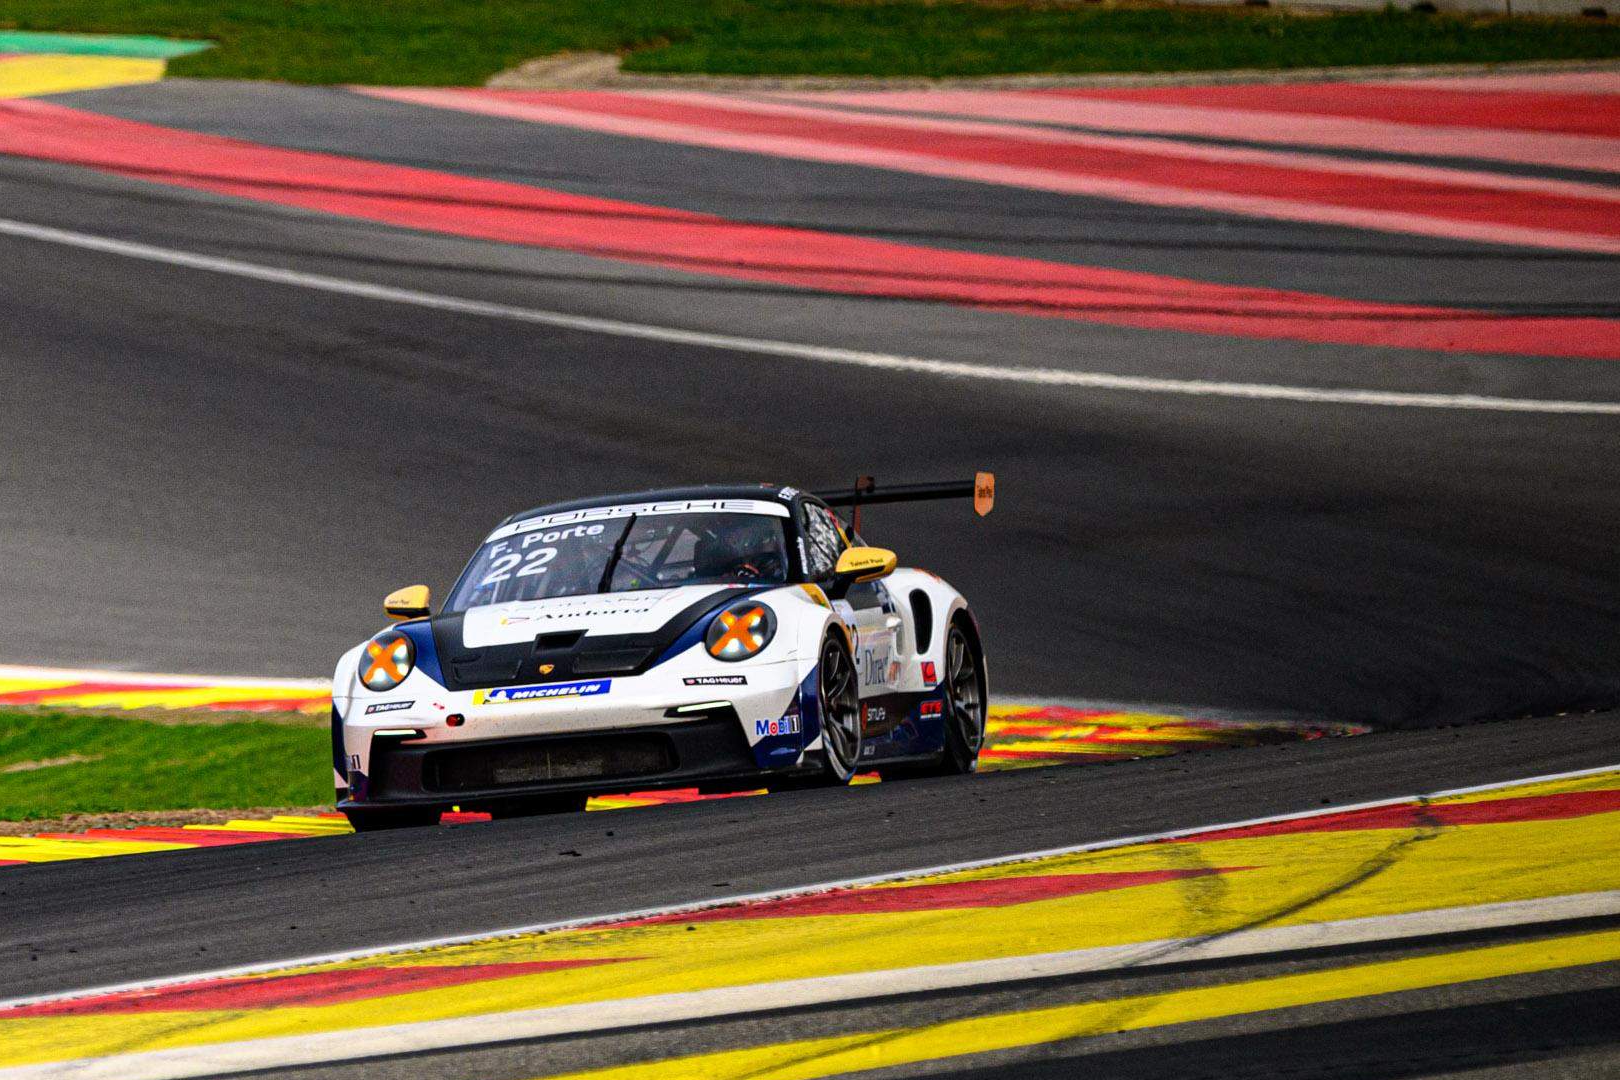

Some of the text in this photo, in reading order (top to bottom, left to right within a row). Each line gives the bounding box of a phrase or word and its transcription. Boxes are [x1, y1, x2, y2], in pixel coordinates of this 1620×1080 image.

[489, 524, 605, 559] F. Porte
[481, 547, 558, 585] 22
[511, 684, 601, 699] MICHELIN
[755, 715, 799, 736] Mobil 1
